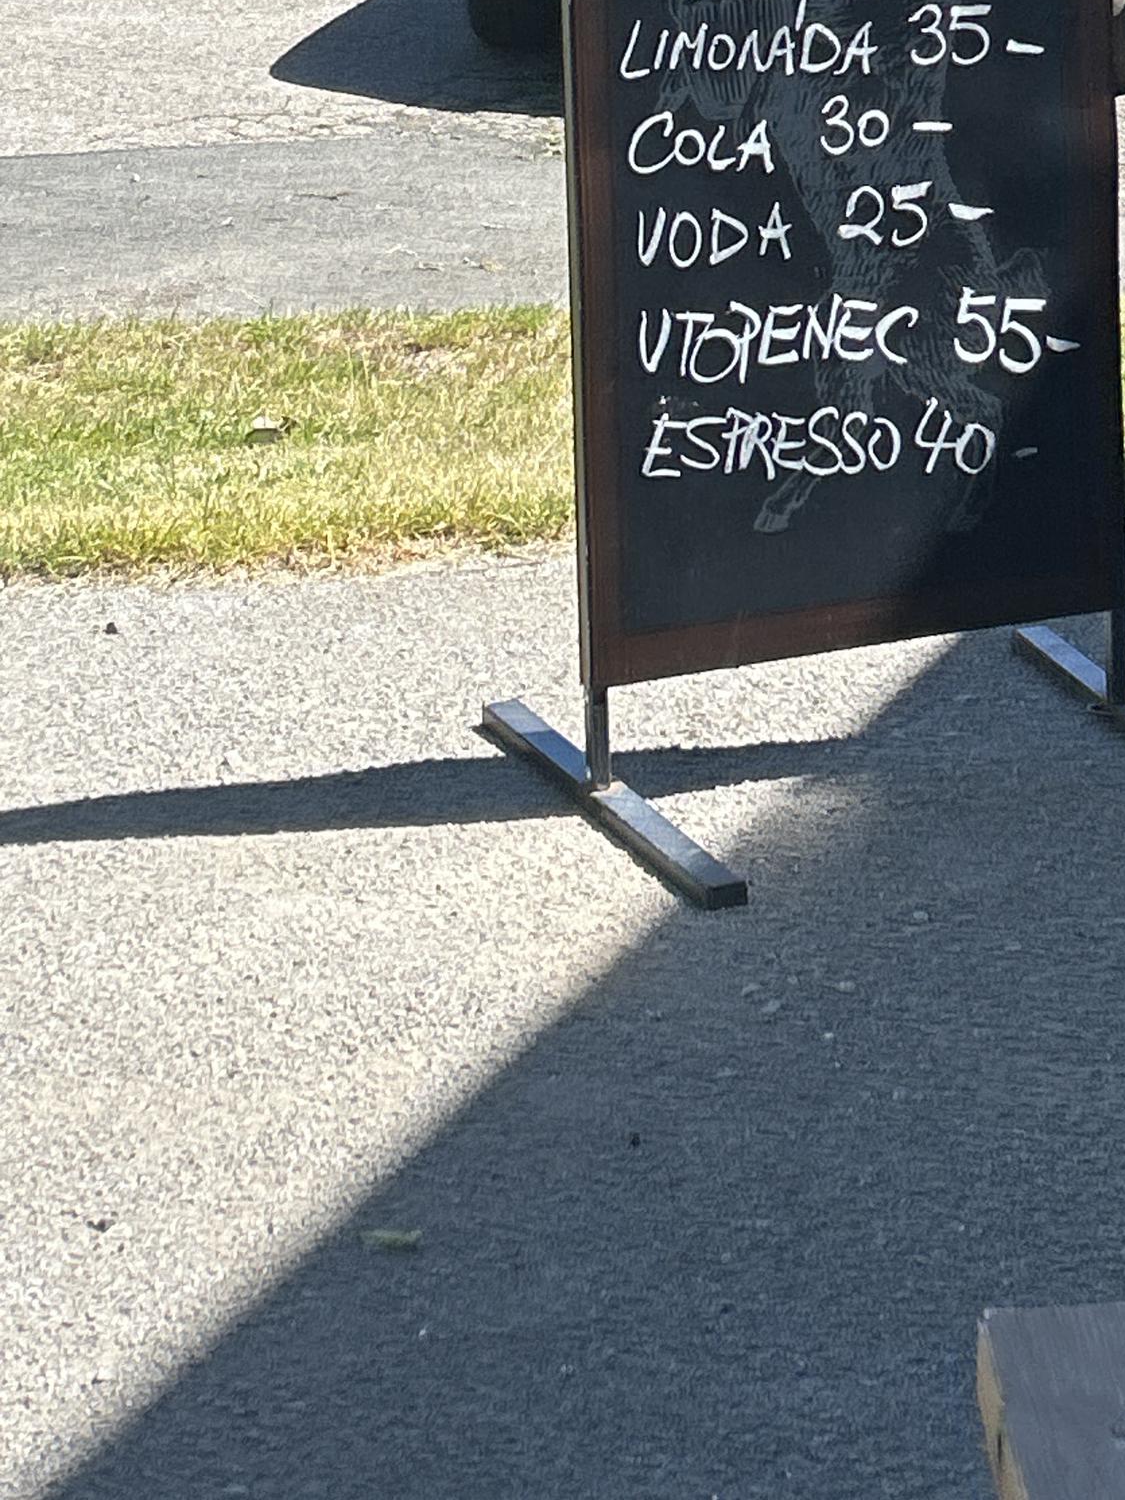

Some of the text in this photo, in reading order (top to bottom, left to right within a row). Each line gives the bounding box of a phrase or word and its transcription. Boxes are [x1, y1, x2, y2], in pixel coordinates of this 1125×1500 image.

[628, 110, 774, 174] COLA
[637, 202, 792, 268] VODA
[641, 405, 900, 481] ESPRESSO
